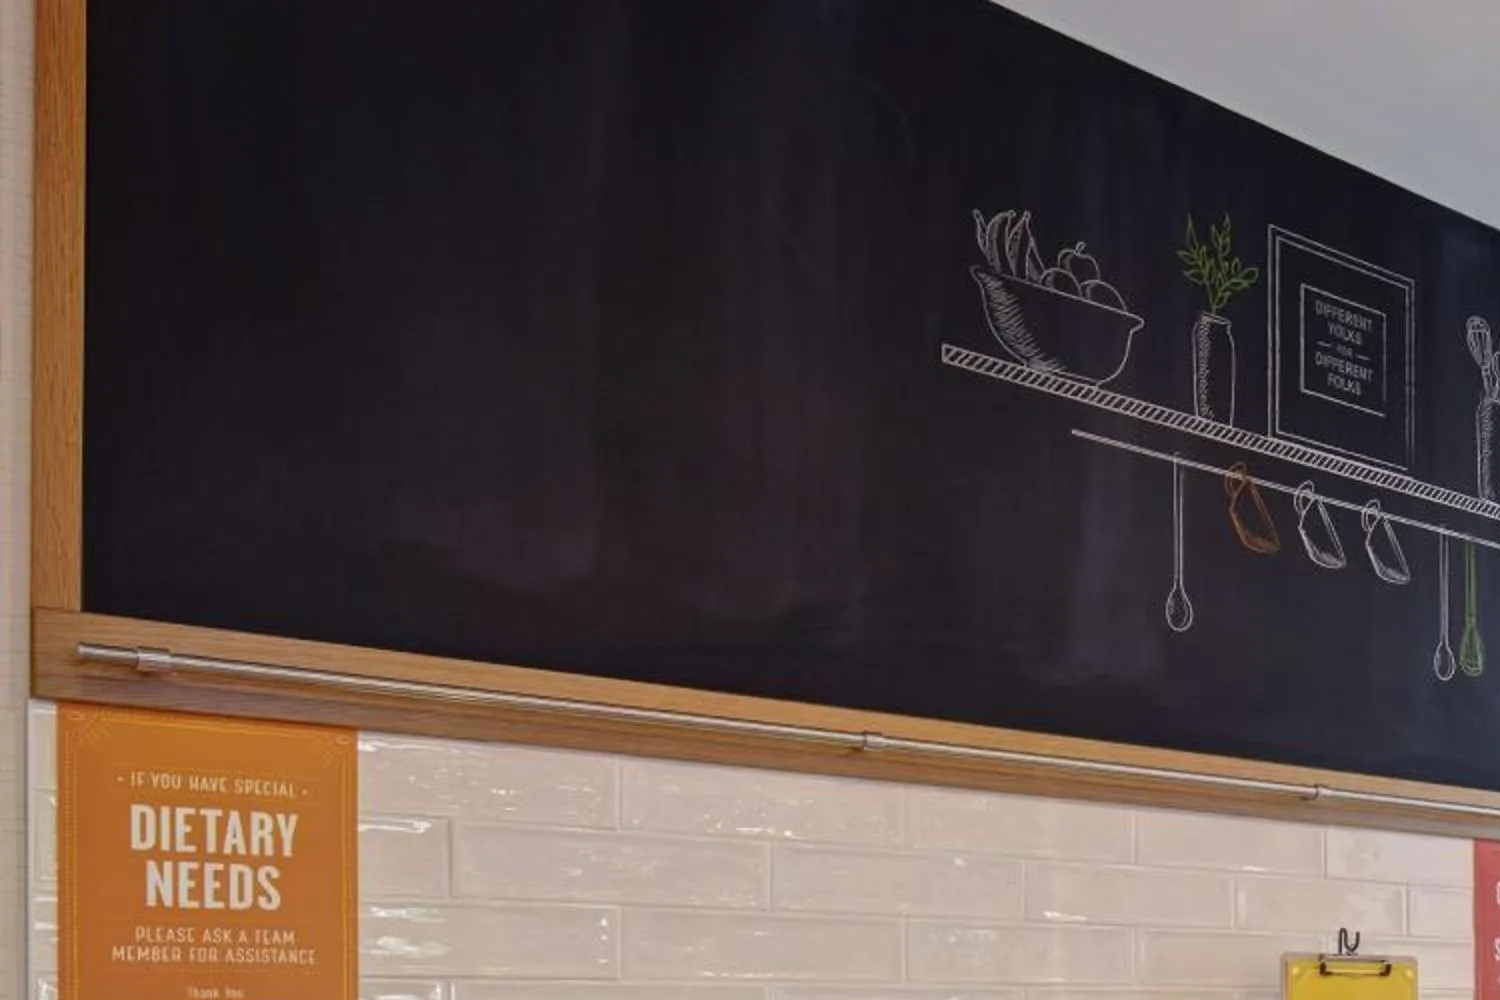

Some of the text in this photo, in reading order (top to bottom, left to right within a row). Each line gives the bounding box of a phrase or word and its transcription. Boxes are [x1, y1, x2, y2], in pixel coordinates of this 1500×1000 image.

[1315, 300, 1373, 332] DIFFERENT
[1327, 320, 1362, 345] YOLKS
[1314, 351, 1374, 383] DIFFERENT
[1327, 372, 1361, 396] FOLKS
[130, 771, 297, 799] IF YOU HAVE SPECIAL
[130, 803, 299, 858] DIETARY
[145, 859, 282, 911] NEEDS
[135, 926, 296, 946] PLEASE ASK A TEAM
[111, 946, 316, 966] MEMBER FOR ASSISTANCE
